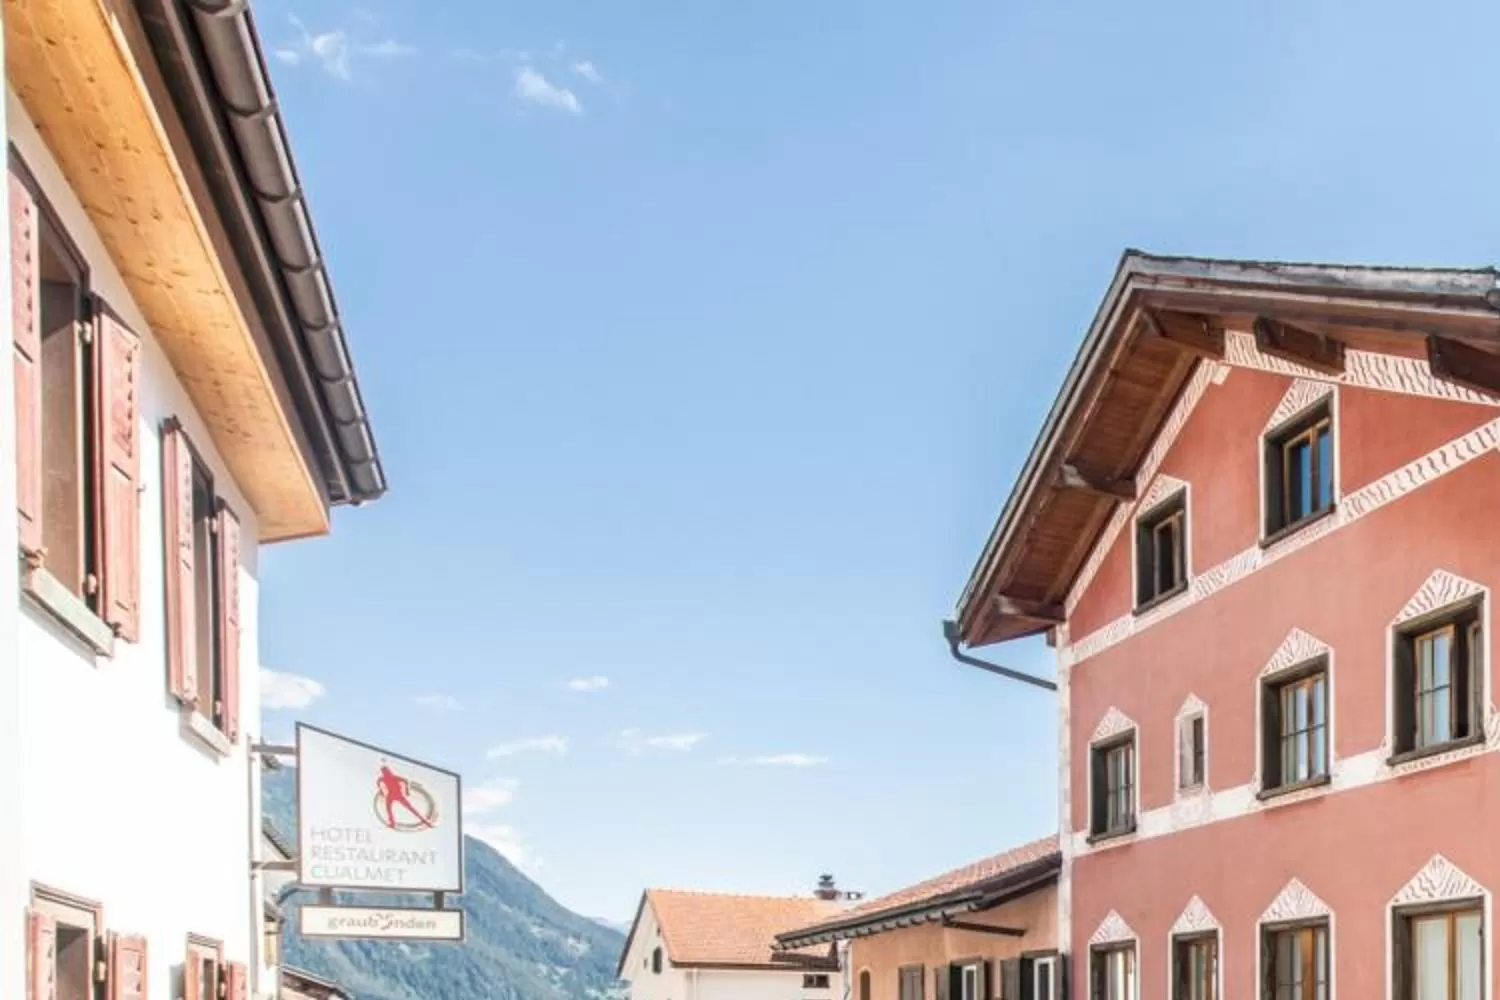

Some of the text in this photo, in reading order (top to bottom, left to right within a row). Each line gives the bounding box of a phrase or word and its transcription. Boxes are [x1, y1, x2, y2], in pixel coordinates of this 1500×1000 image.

[311, 827, 373, 844] HOTEL
[310, 845, 438, 865] RESTAURANT
[310, 864, 407, 882] CUALMET
